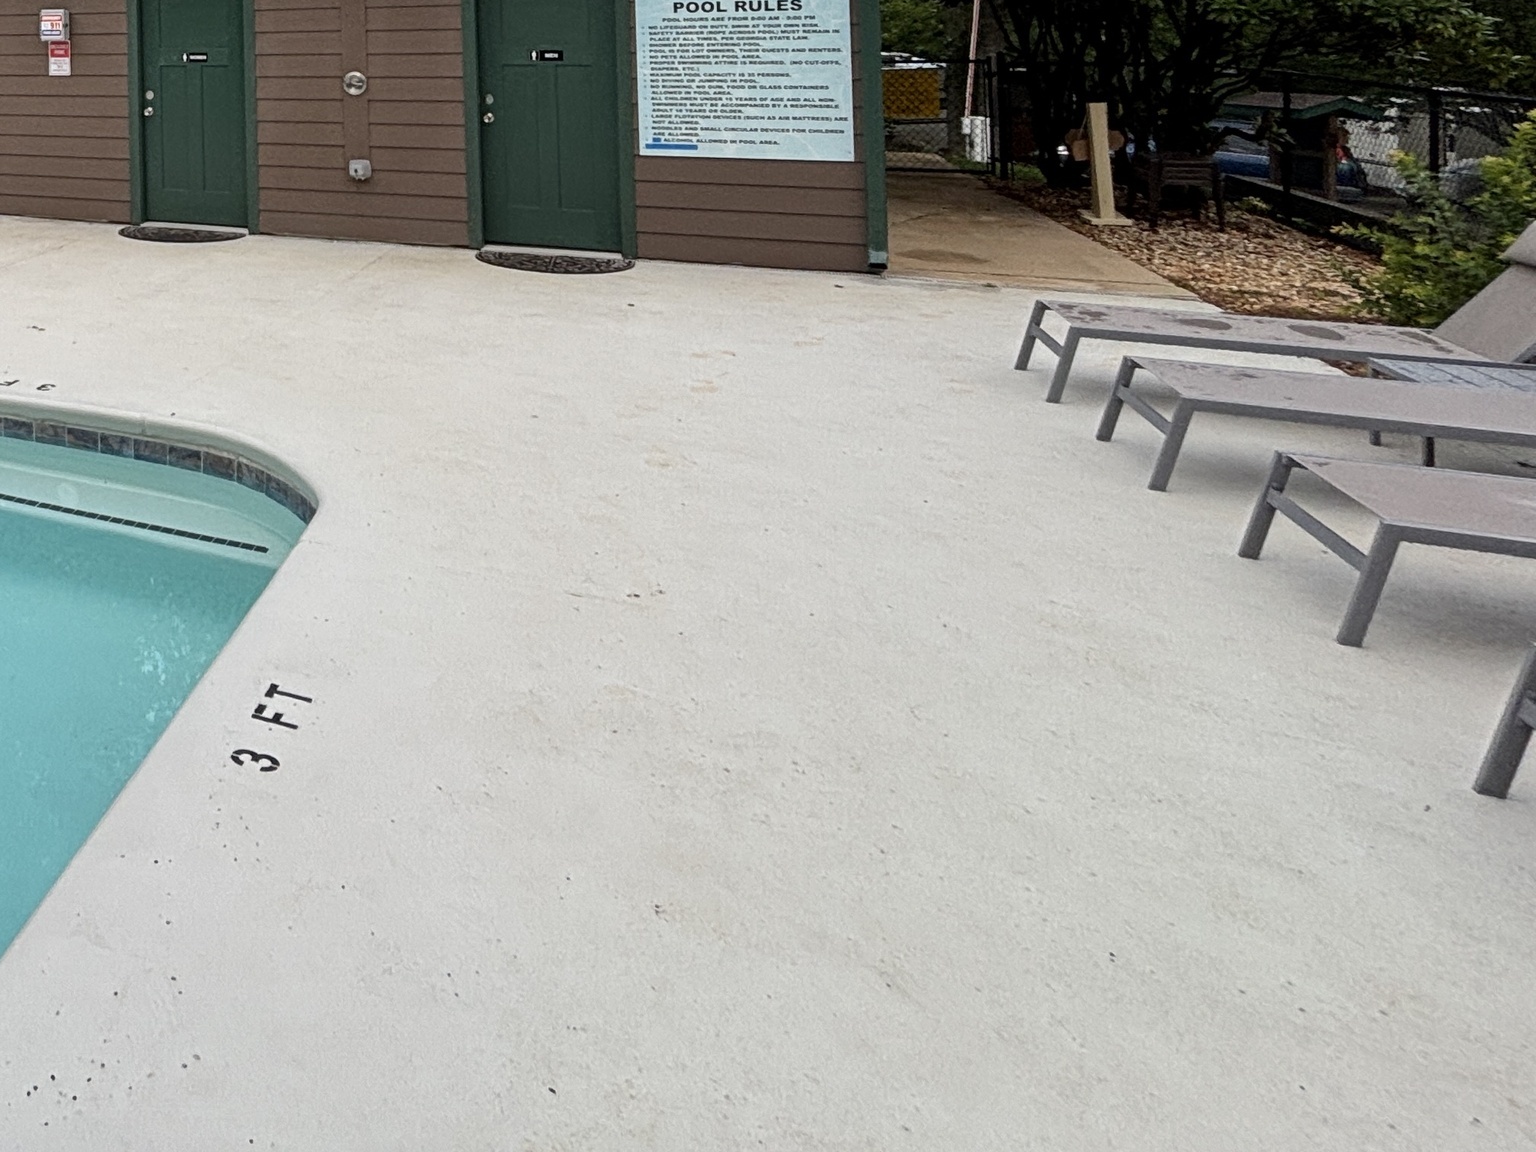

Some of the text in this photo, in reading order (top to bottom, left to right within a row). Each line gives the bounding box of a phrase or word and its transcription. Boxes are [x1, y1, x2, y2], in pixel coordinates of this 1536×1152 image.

[673, 0, 802, 13] POOL RULES
[230, 683, 313, 772] 3 FT
